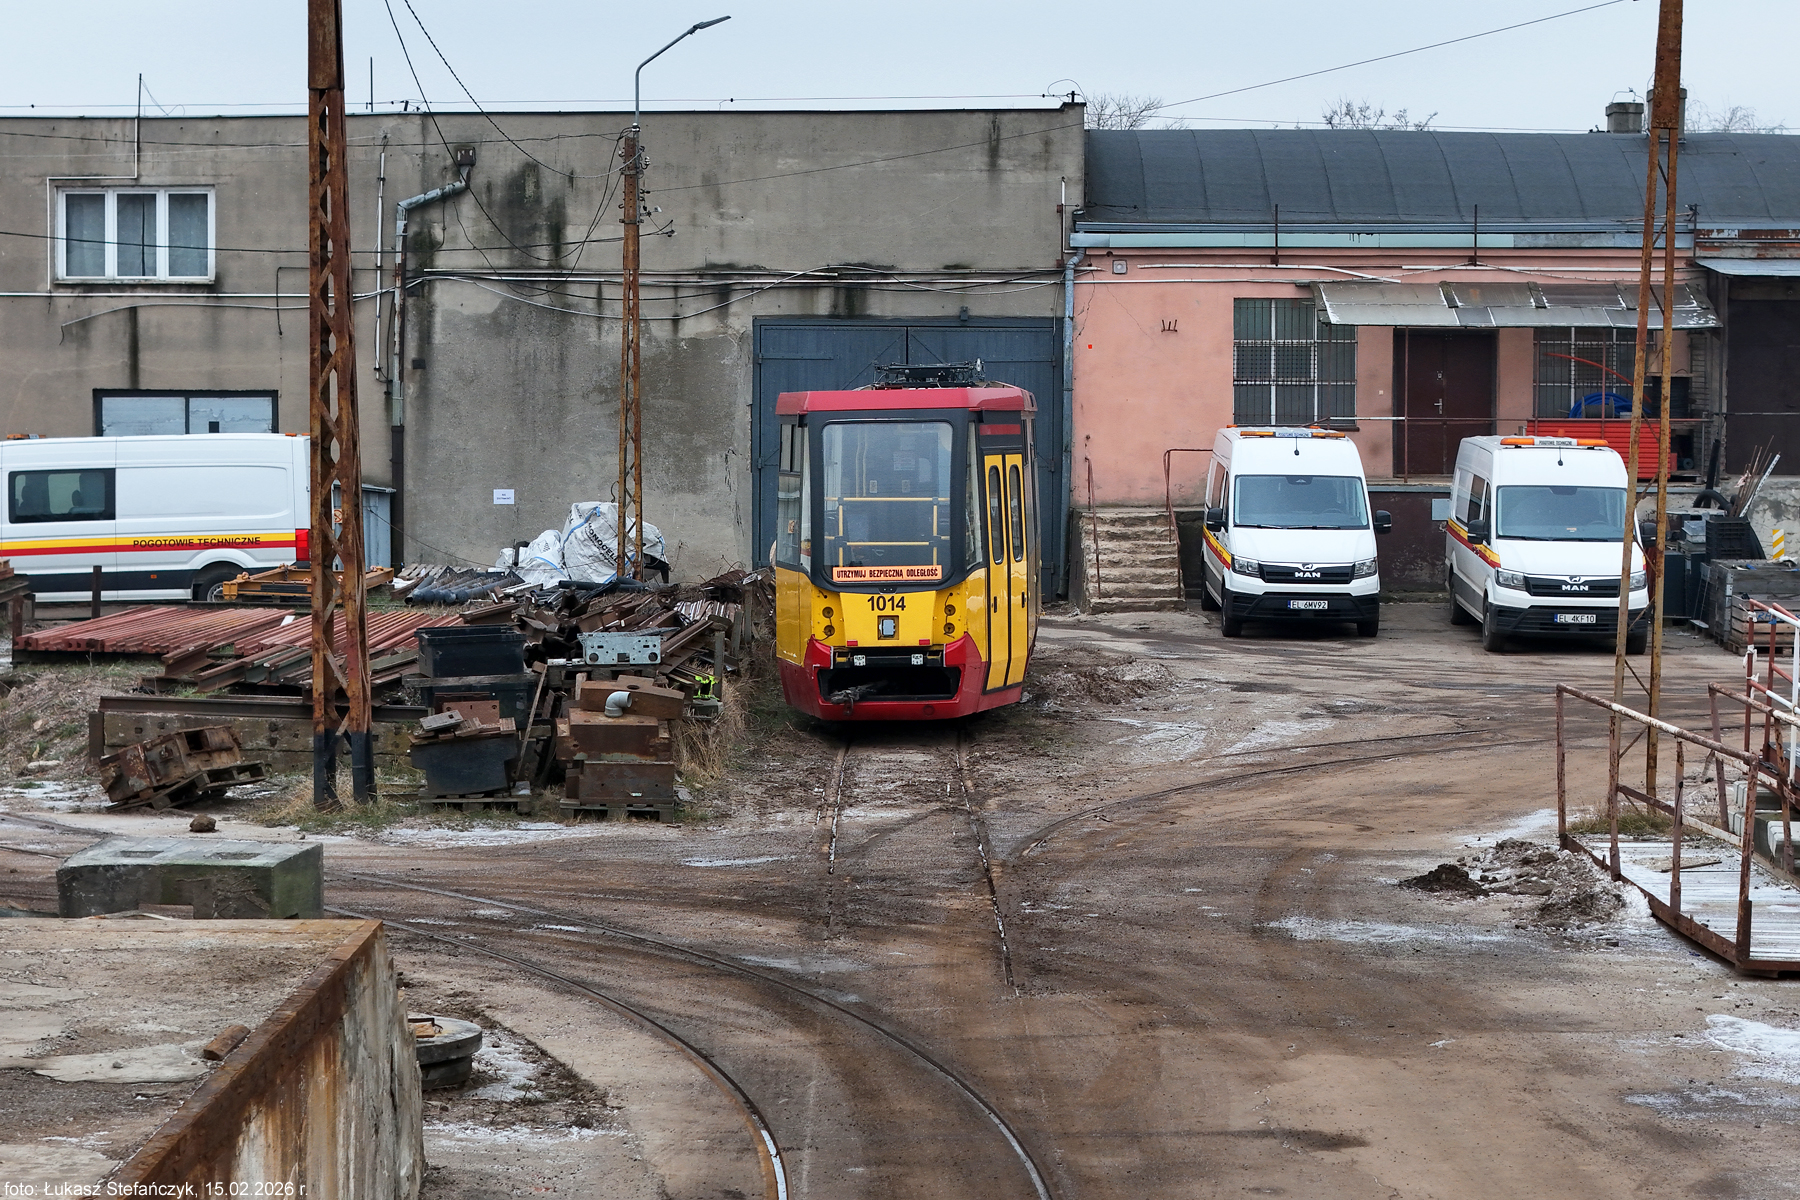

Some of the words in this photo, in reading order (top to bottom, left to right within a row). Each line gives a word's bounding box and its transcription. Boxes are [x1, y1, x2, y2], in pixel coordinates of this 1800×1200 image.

[133, 538, 194, 548] POGOTOWIE
[198, 536, 261, 547] TECHNICZNE
[836, 569, 867, 579] UTRZYMUJ
[869, 568, 904, 579] BEZPIECZNĄ
[906, 566, 938, 577] ODLEGŁOŚĆ
[867, 595, 907, 612] 1014
[1292, 601, 1301, 609] EL
[1303, 601, 1327, 609] 6MV92
[1558, 614, 1569, 623] EL
[1571, 615, 1595, 623] 4KF10
